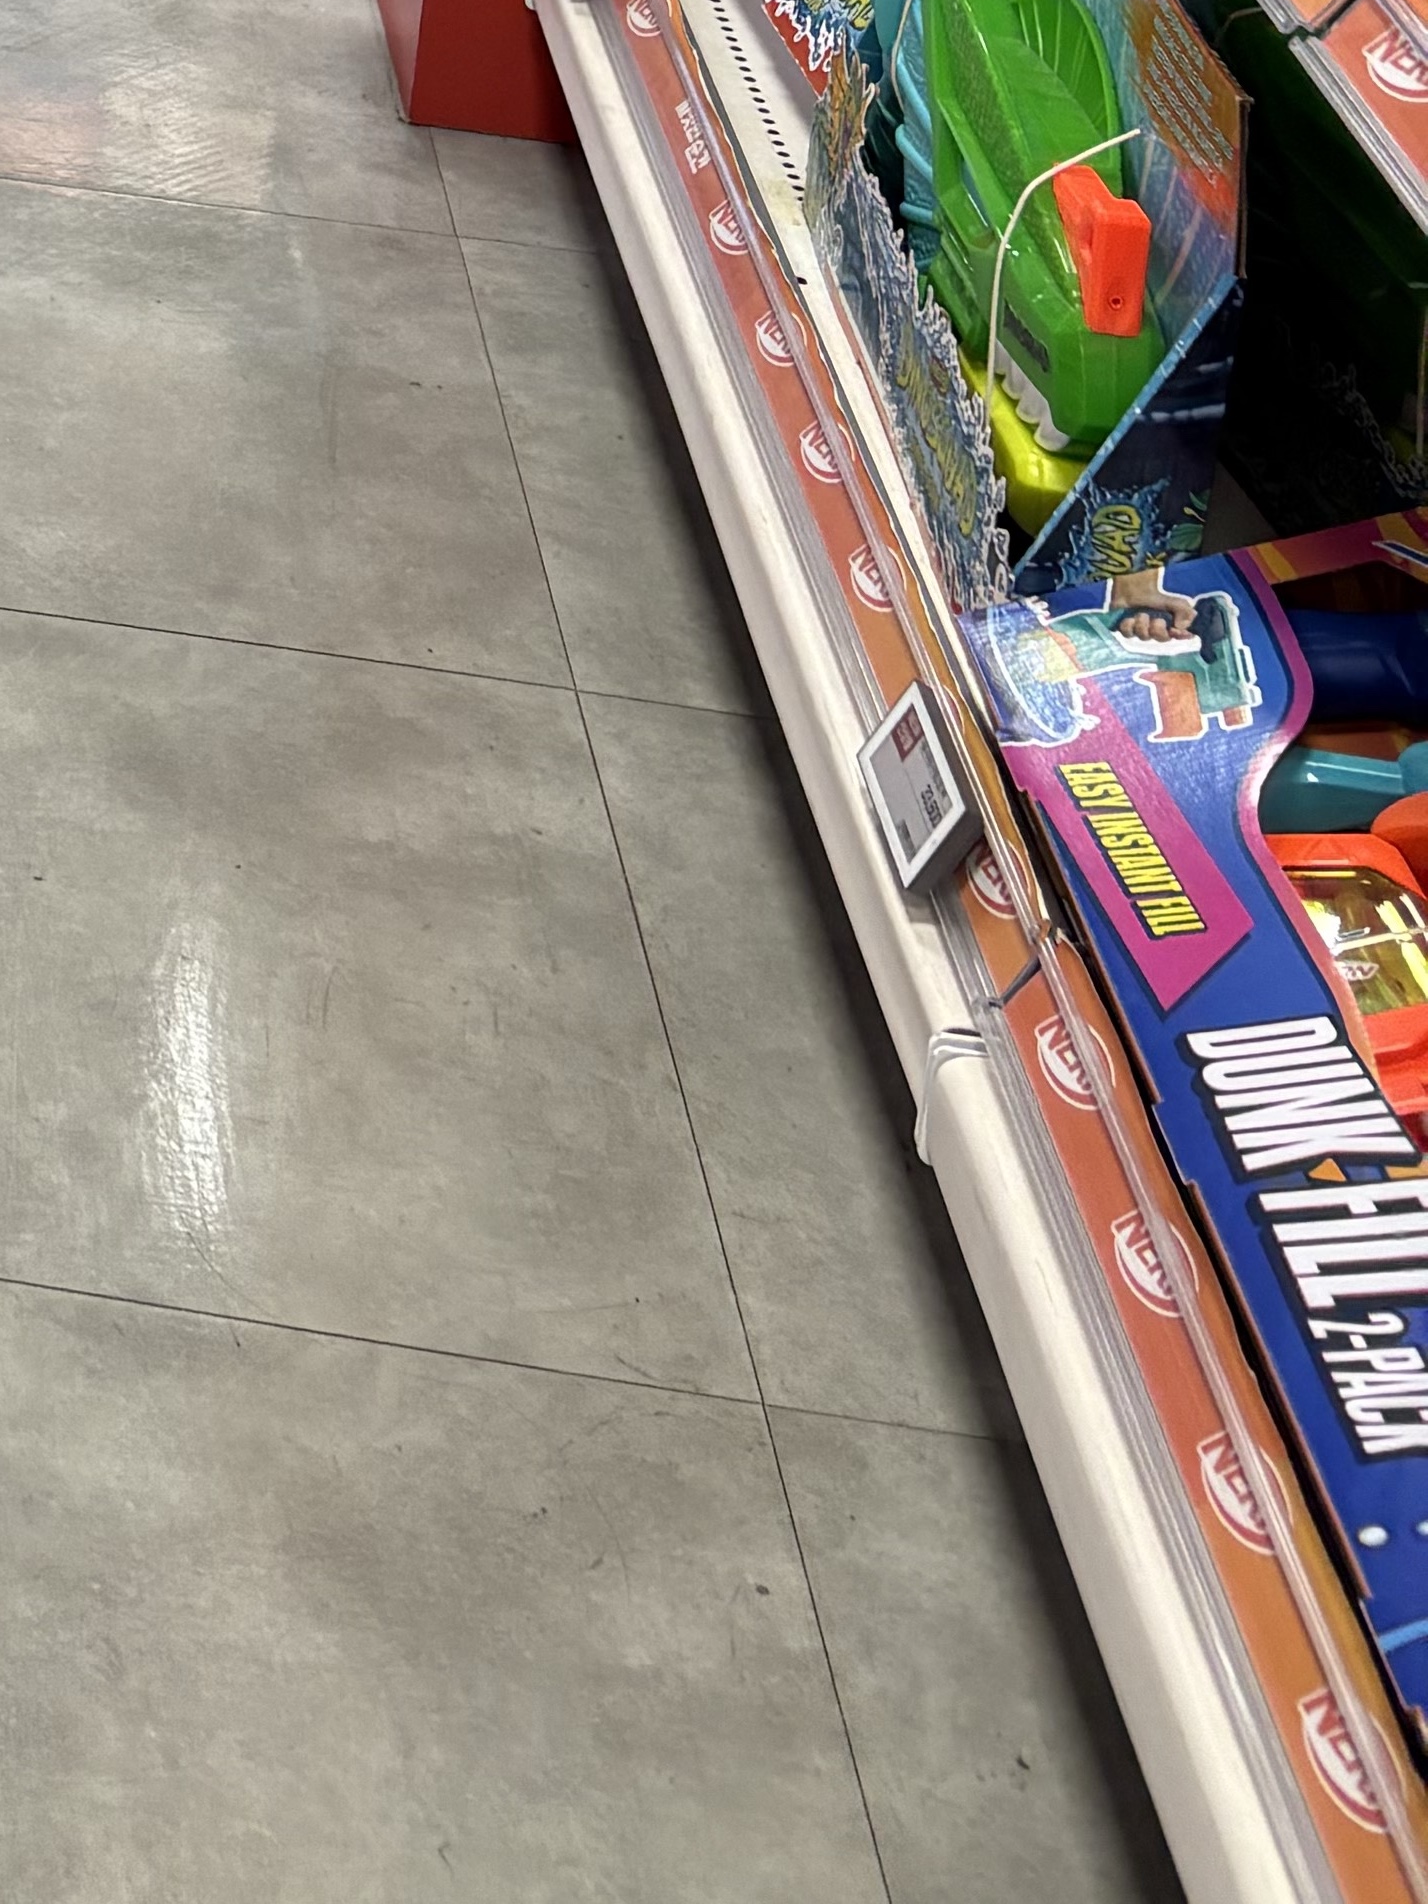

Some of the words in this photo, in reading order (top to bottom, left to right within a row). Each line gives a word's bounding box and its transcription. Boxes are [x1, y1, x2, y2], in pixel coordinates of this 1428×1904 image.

[1058, 761, 1133, 809] EASY
[1090, 811, 1184, 895] INSTANT
[1134, 895, 1207, 938] FILL
[1186, 1015, 1417, 1172] DUNK
[1257, 1178, 1428, 1310] FILL
[1307, 1309, 1428, 1456] 2-PACK
